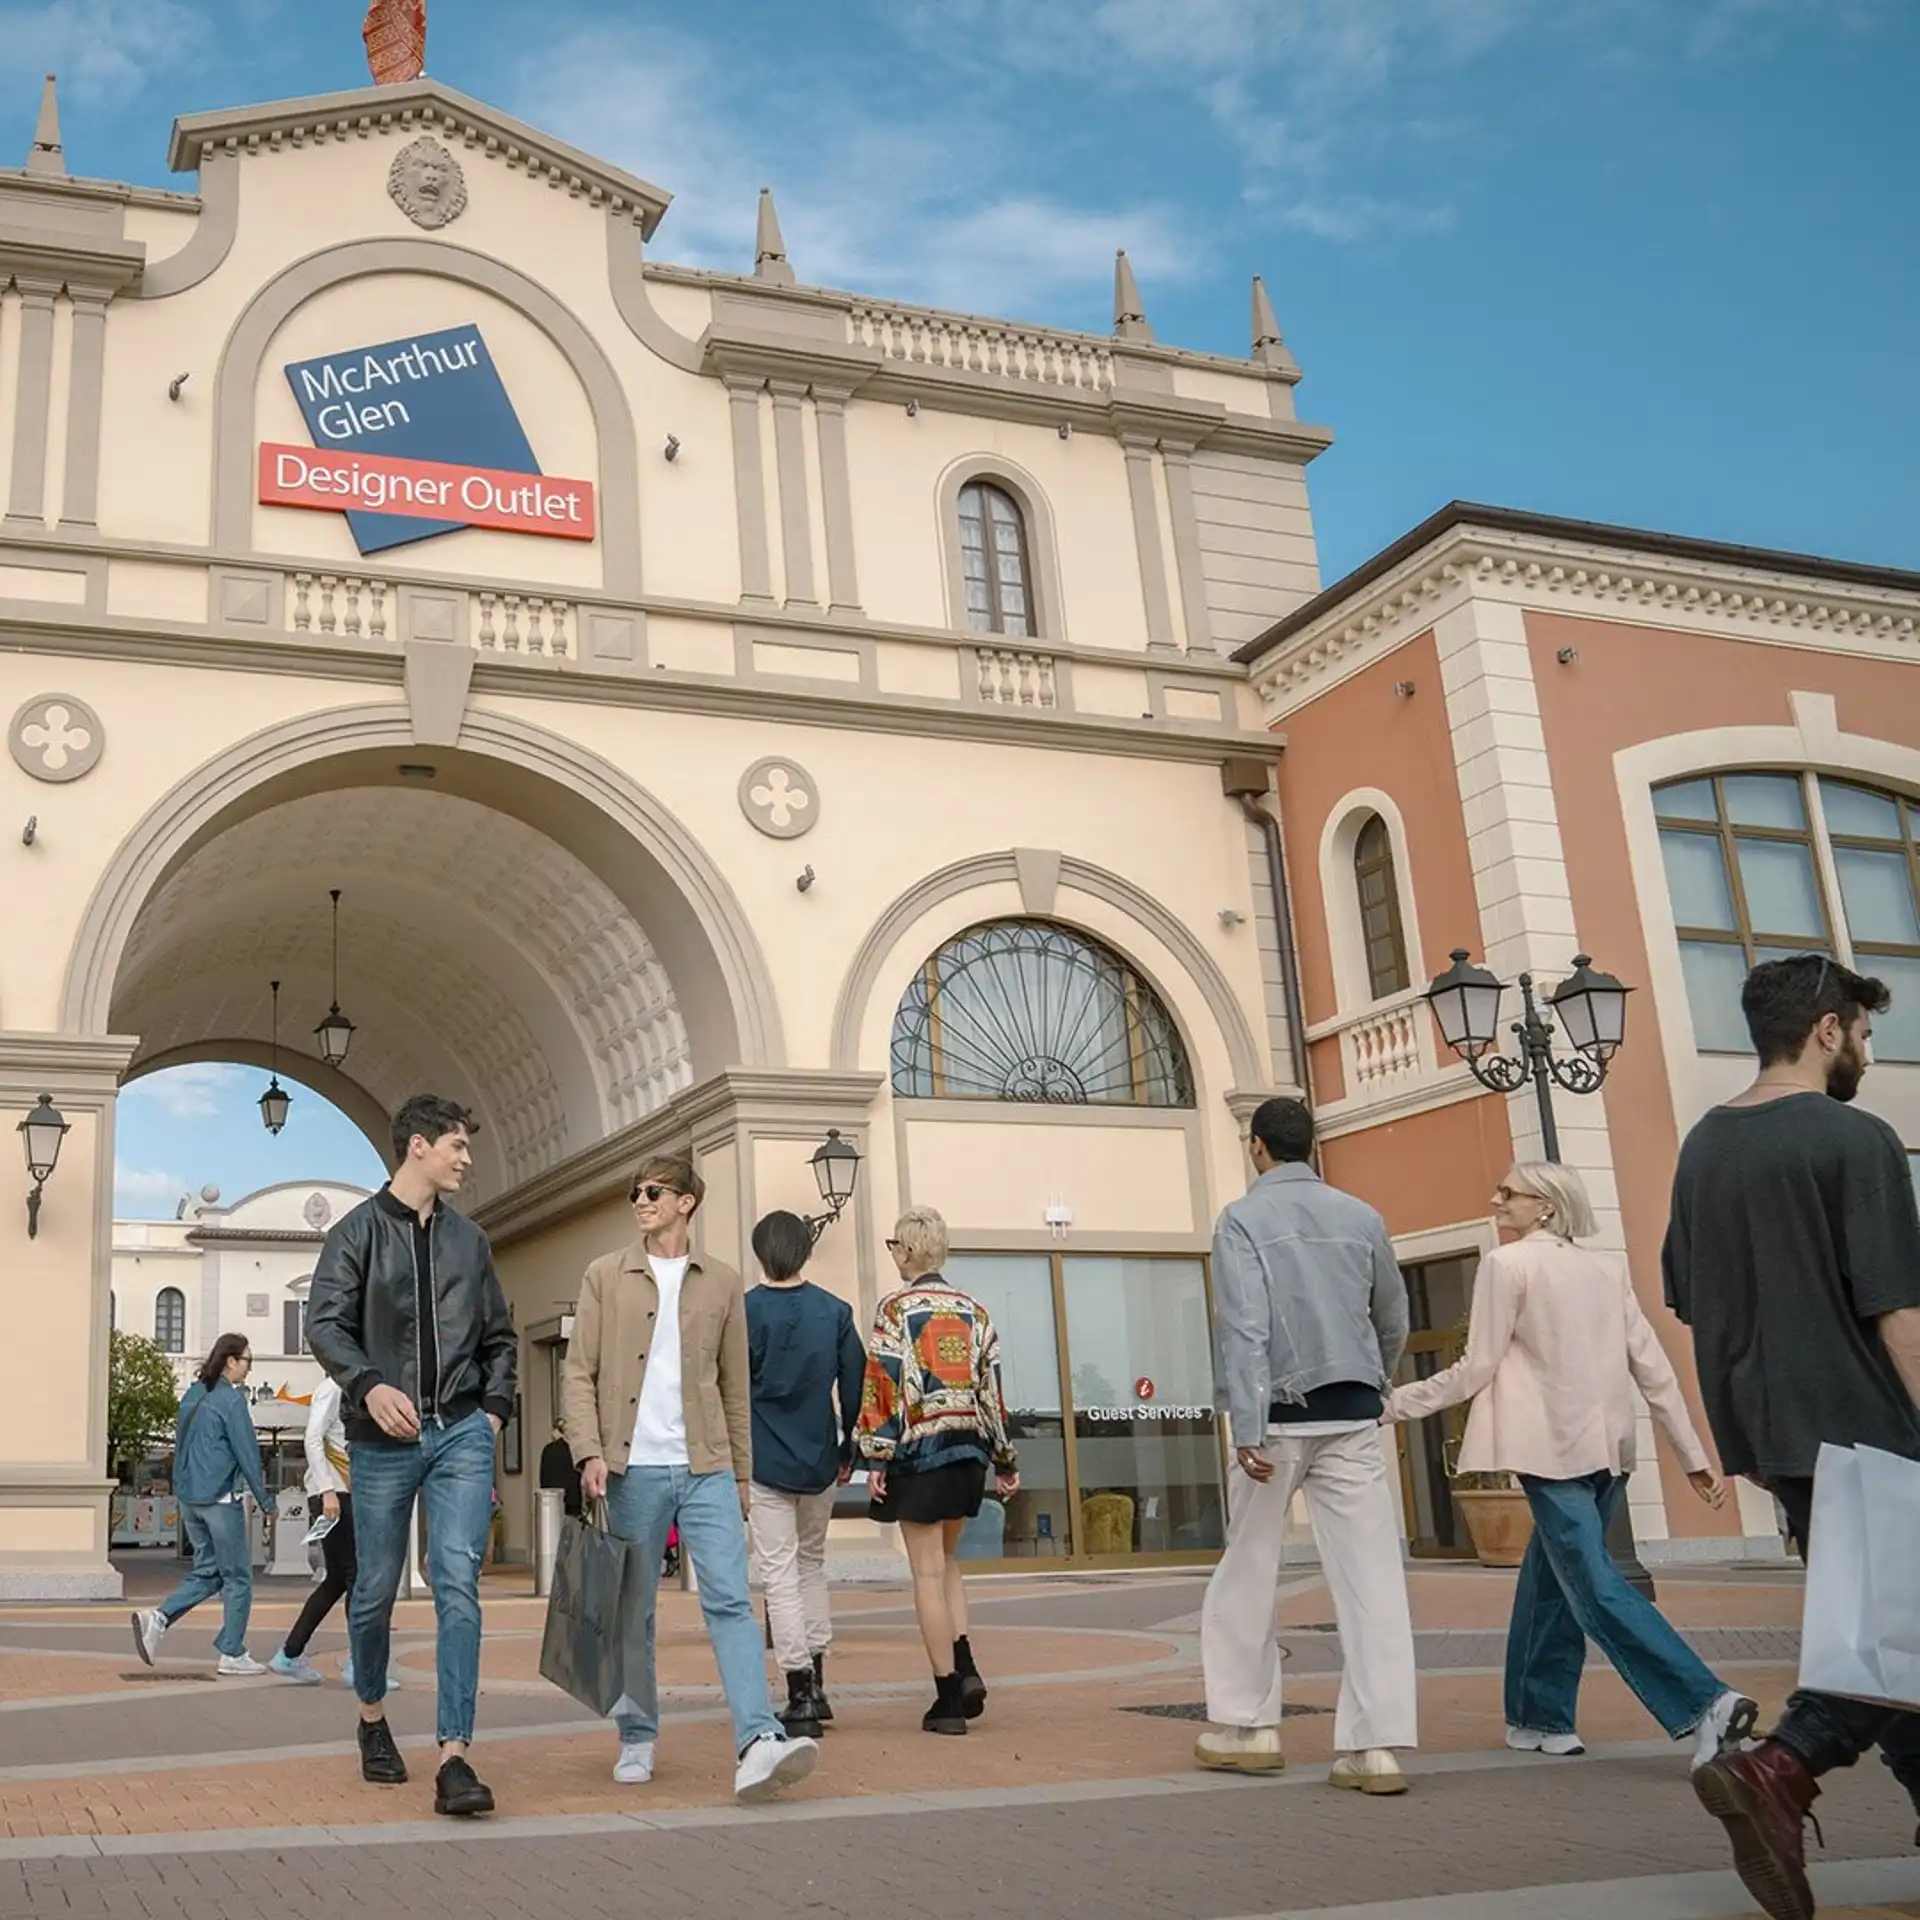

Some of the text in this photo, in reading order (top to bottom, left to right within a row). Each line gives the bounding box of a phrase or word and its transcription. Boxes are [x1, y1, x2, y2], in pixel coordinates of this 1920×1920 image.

[300, 340, 478, 402] McArthur
[317, 399, 411, 440] Glen
[276, 453, 582, 522] Designer Outlet
[1087, 1404, 1202, 1421] Guest Services
